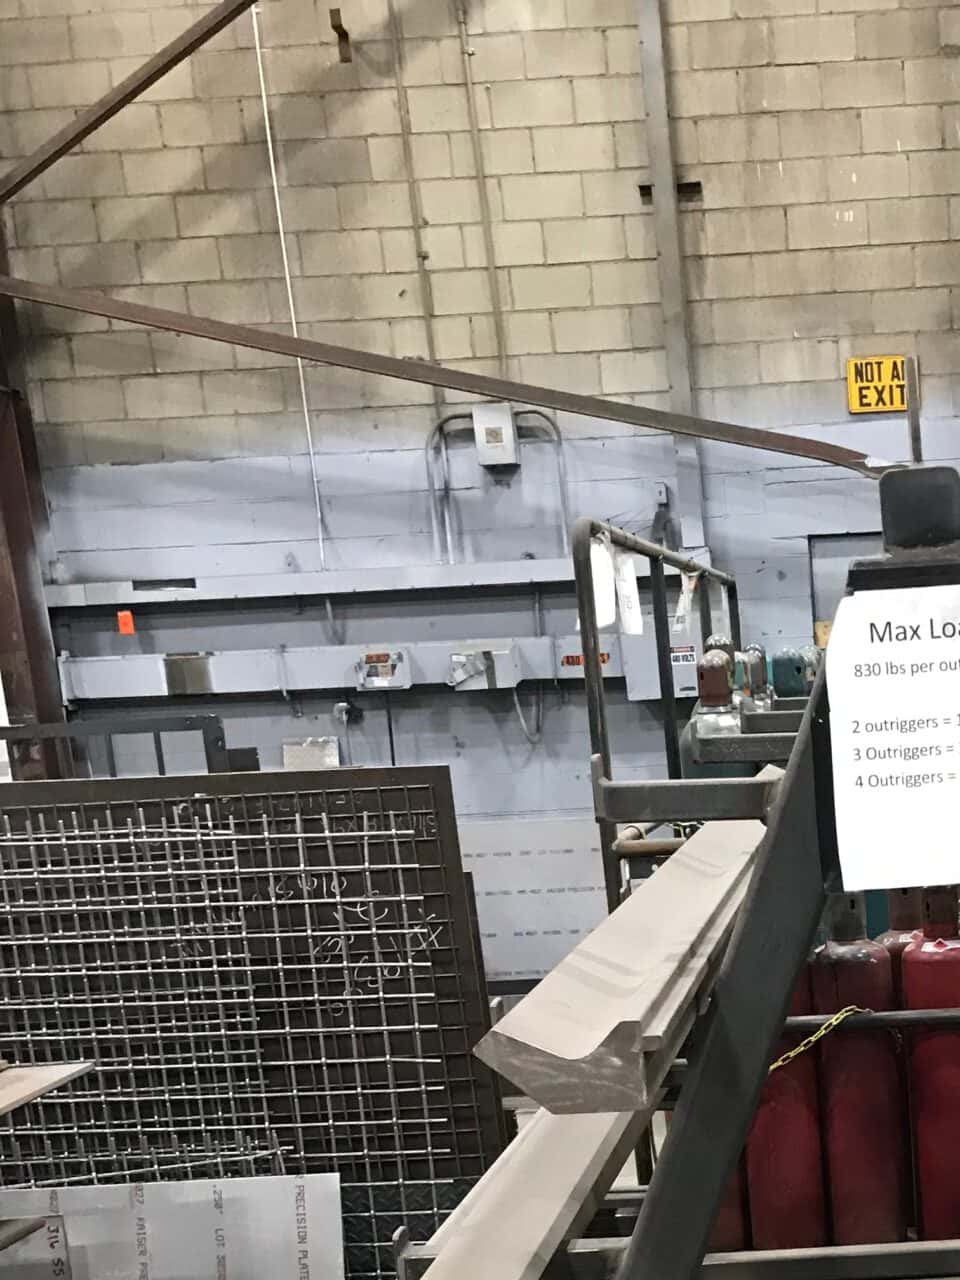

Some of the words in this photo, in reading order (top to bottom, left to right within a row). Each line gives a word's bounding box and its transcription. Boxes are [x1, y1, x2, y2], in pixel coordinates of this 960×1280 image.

[854, 361, 883, 383] NOT
[891, 360, 905, 381] A
[858, 384, 905, 407] EXIT
[869, 621, 922, 644] Max
[854, 662, 882, 678] 830
[885, 661, 907, 675] lbs
[910, 661, 935, 677] per
[852, 720, 861, 734] 2
[865, 716, 939, 733] outriggers
[943, 717, 952, 725] =
[853, 748, 862, 761] 3
[866, 744, 942, 761] Outriggers
[855, 775, 864, 788] 4
[868, 772, 944, 788] Outriggers
[295, 1184, 308, 1245] PRECISION
[214, 1228, 226, 1249] LOT
